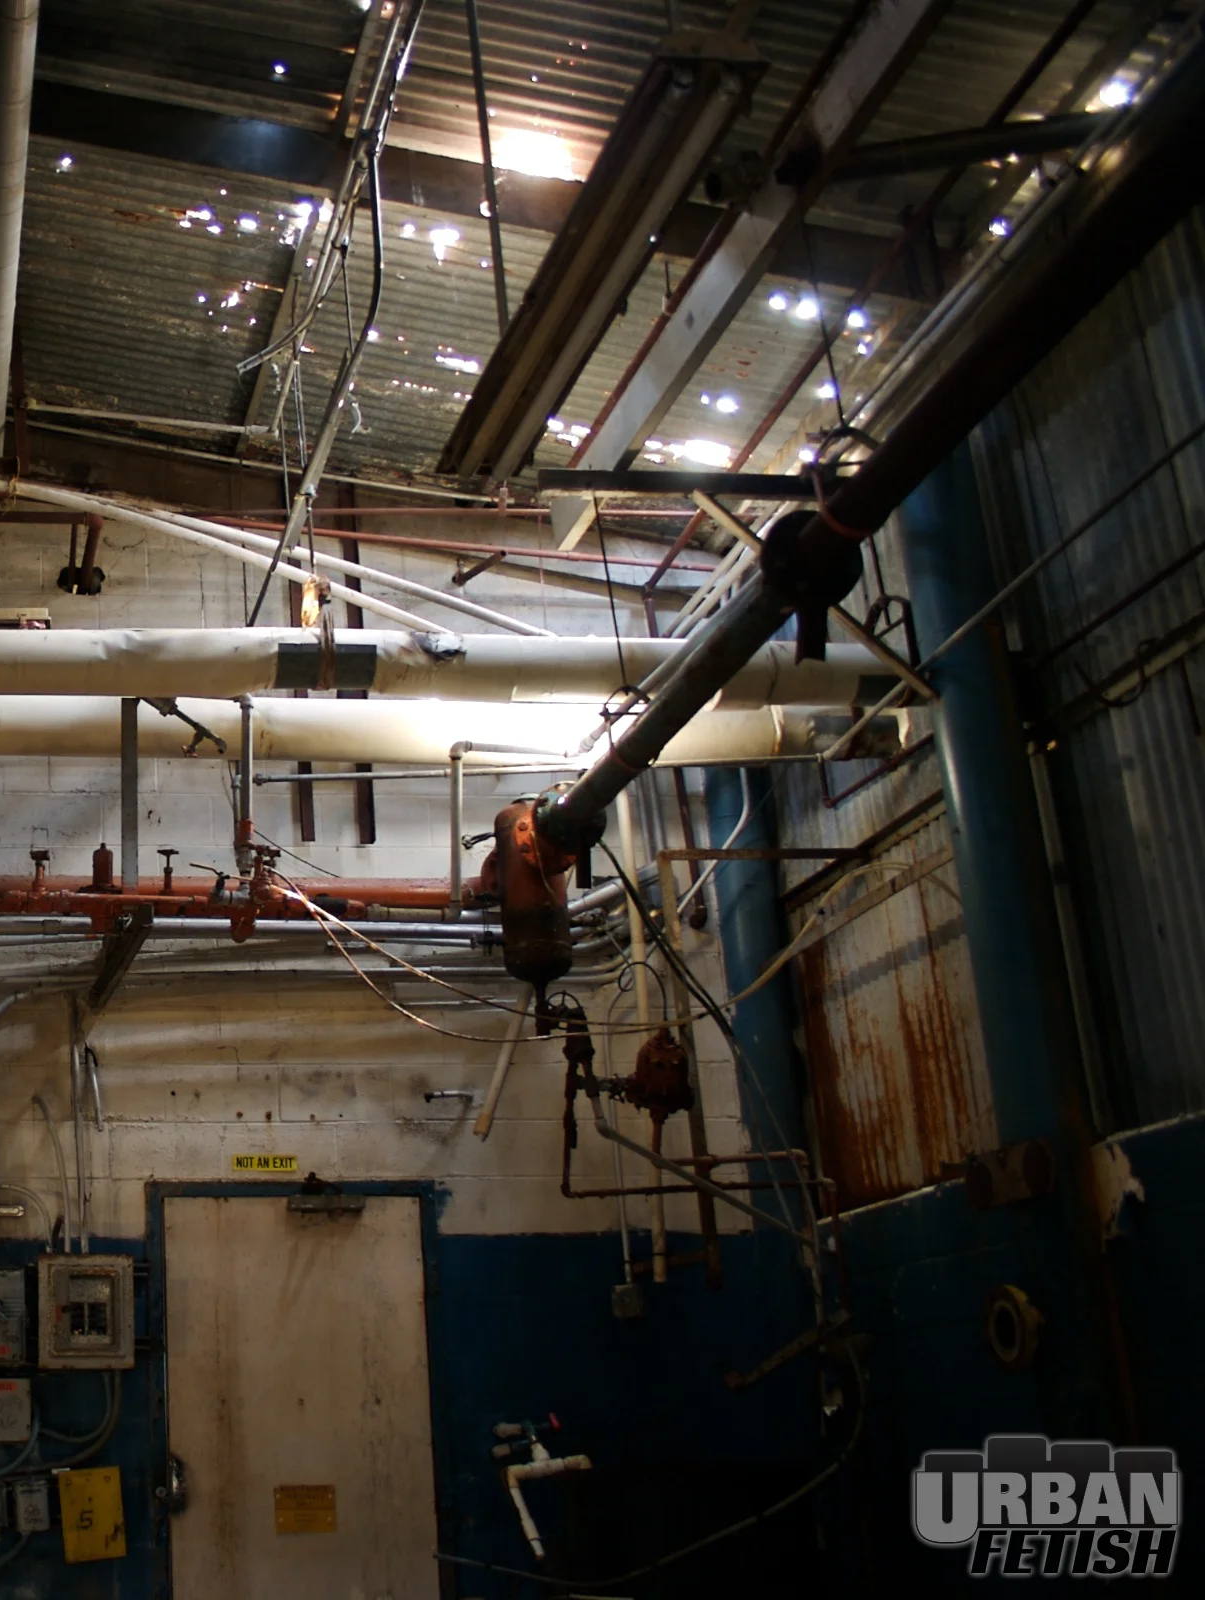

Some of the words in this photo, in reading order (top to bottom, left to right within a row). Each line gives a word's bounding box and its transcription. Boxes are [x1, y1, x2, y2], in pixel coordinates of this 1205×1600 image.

[236, 1156, 255, 1168] NOT
[257, 1156, 270, 1168] AN
[273, 1157, 294, 1168] EXIT
[78, 1508, 94, 1529] 5
